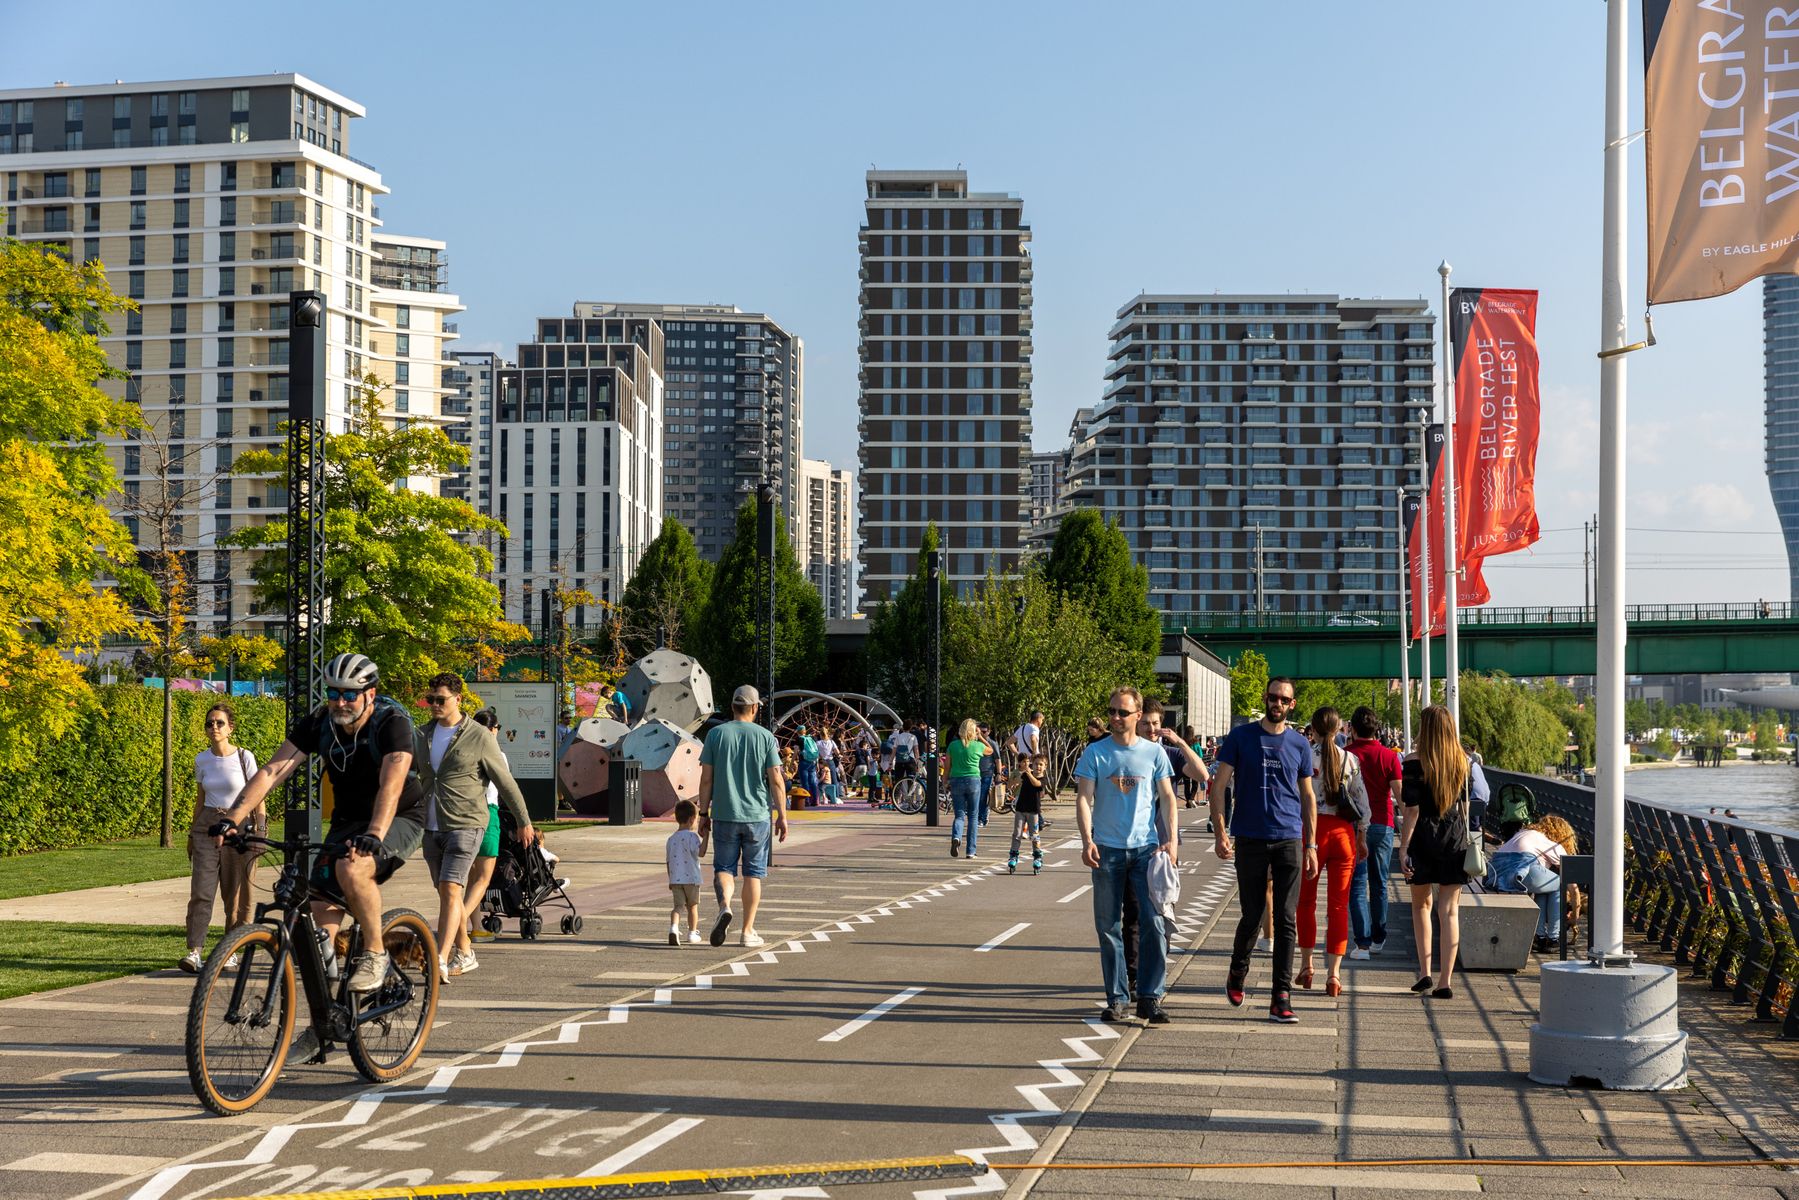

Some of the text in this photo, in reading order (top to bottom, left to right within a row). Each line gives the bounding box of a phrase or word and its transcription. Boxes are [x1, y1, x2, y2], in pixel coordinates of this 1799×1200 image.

[1702, 247, 1720, 257] BY
[1723, 243, 1768, 256] EAGLE
[1460, 301, 1486, 314] BW
[1487, 307, 1527, 315] WATERFRONT
[1477, 337, 1497, 460] BELGRADE
[1499, 337, 1518, 458] RIVER FEST
[1471, 534, 1497, 550] JUN
[1117, 778, 1136, 787] 1908
[315, 1099, 674, 1157] PAZI
